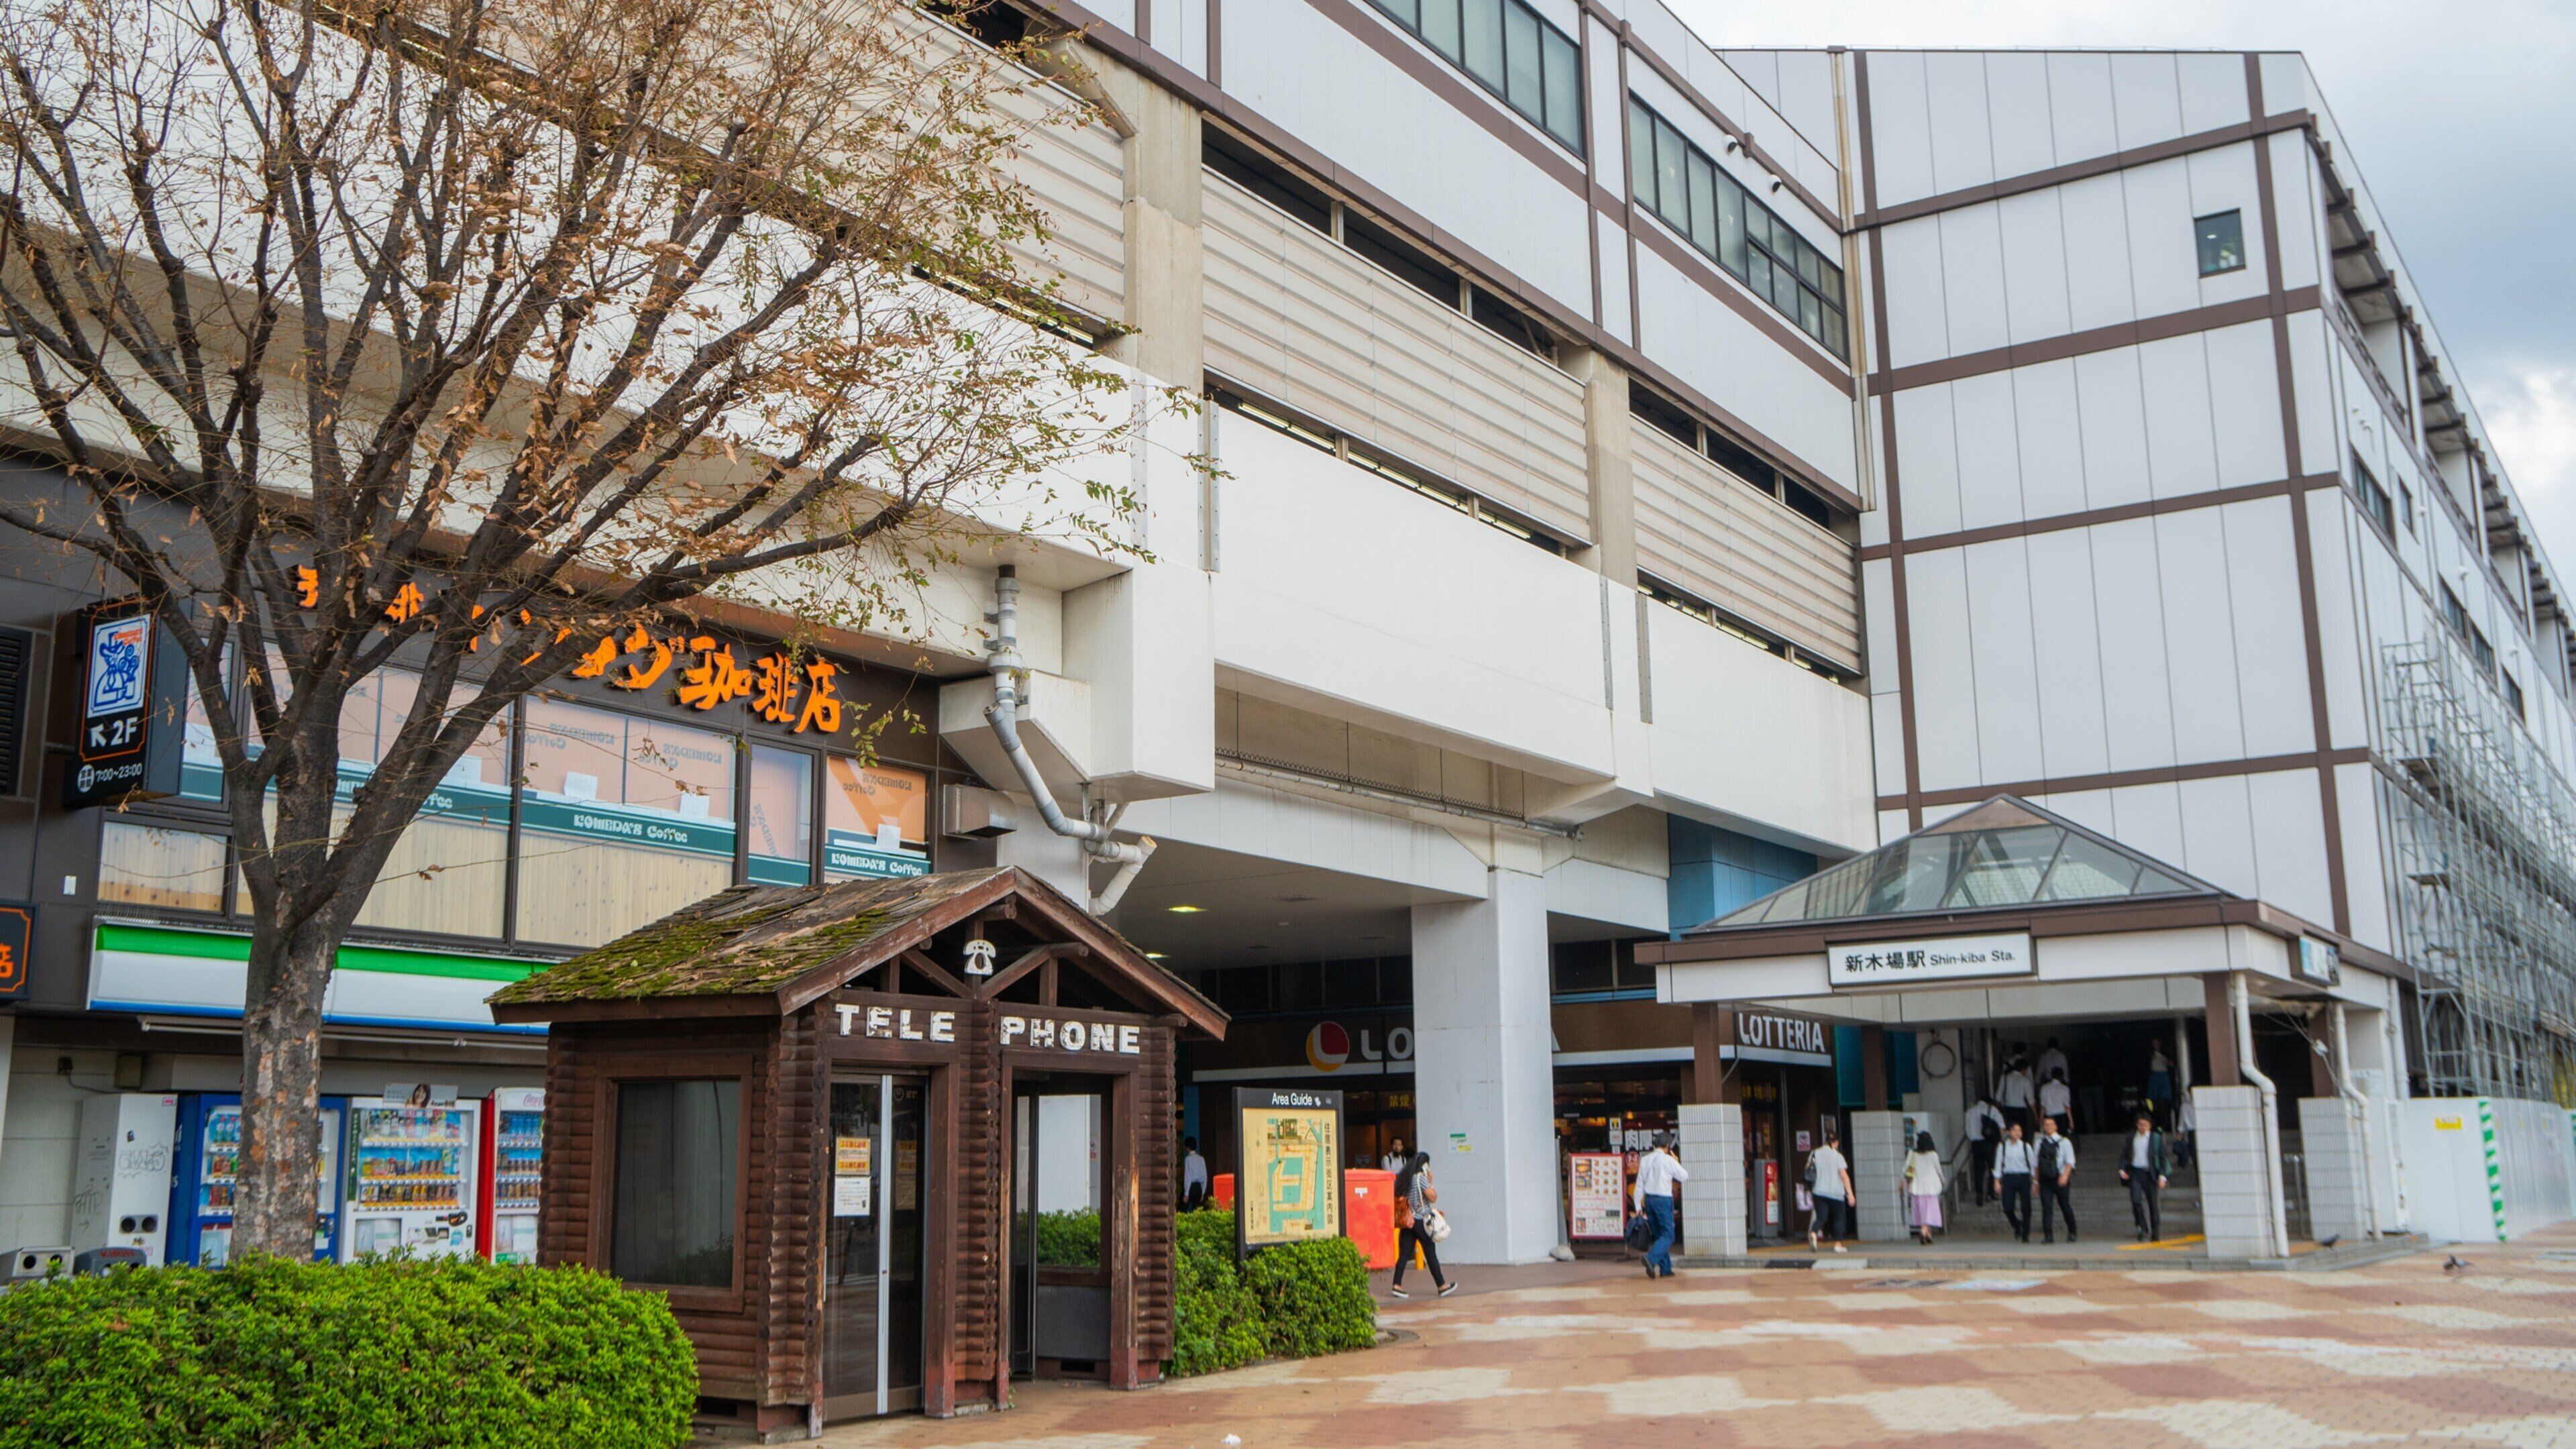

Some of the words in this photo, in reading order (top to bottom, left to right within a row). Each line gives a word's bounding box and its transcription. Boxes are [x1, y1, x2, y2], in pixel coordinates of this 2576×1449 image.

[111, 716, 138, 746] 2F
[1845, 950, 1926, 973] 新木場駅
[1930, 953, 1986, 966] Shin-kiba
[1991, 949, 2016, 961] Sta.
[835, 1004, 955, 1042] TELE
[1000, 1016, 1140, 1054] PHONE
[1738, 1012, 1826, 1053] LOTTERIA
[1271, 1092, 1289, 1106] Area
[1291, 1092, 1313, 1106] Guide
